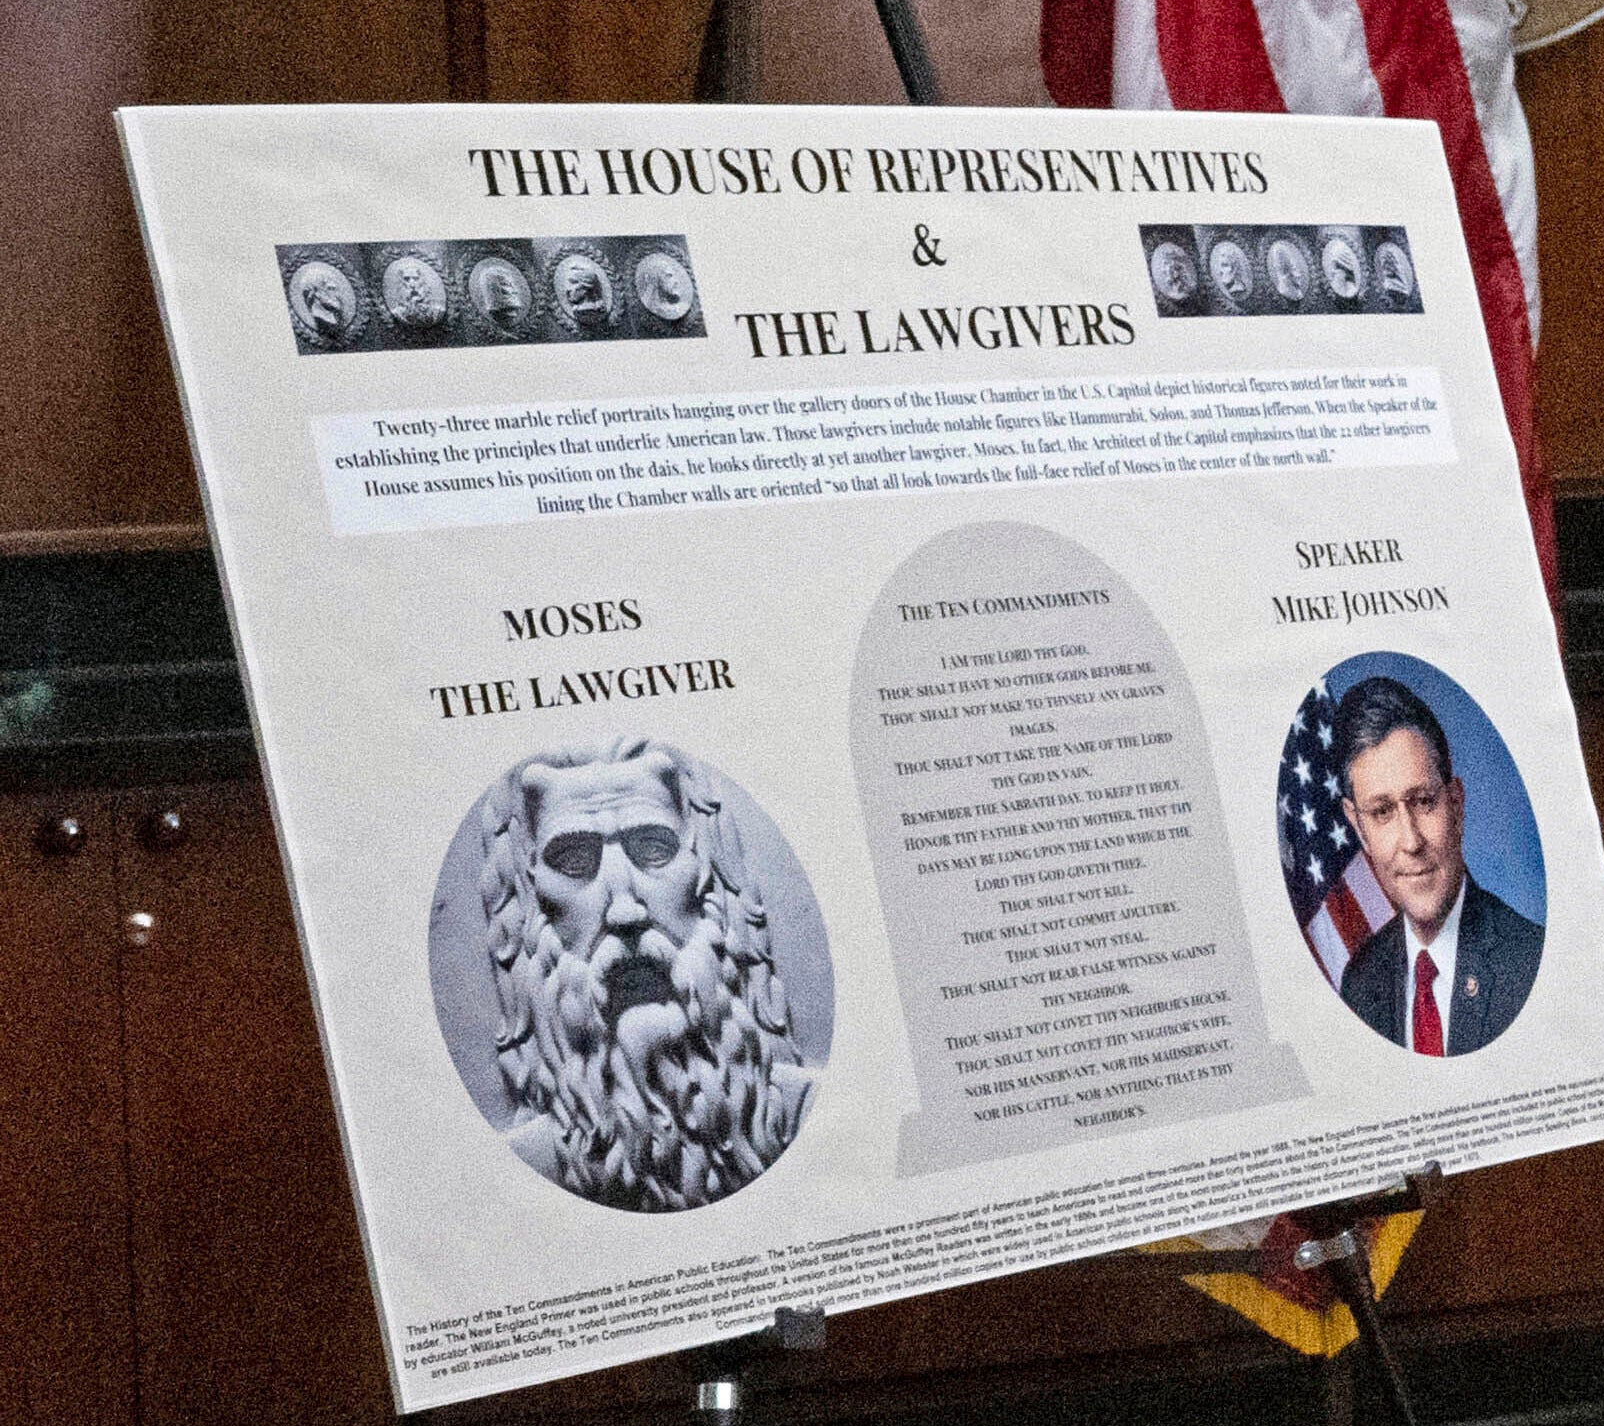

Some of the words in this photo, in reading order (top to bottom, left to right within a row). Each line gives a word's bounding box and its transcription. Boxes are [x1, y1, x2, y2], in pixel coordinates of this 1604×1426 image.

[467, 148, 589, 197] THE
[596, 147, 781, 195] HOUSE
[790, 148, 852, 192] OF
[866, 148, 1268, 193] REPRESENTATIVES
[911, 223, 946, 266] &
[733, 310, 846, 358] THE
[855, 304, 1135, 353] LAWGIVERS
[373, 416, 490, 439] Twenty-three
[493, 409, 552, 431] marble
[555, 406, 598, 426] relief
[600, 404, 670, 427] portraits
[671, 400, 735, 421] hanging
[736, 402, 770, 416] over
[771, 397, 795, 414] the
[798, 395, 846, 416] gallery
[850, 394, 891, 411] doors
[893, 391, 907, 407] of
[909, 390, 932, 407] the
[934, 390, 976, 406] House
[979, 386, 1039, 403] Chamber
[1041, 385, 1055, 401] in
[1056, 384, 1077, 400] the
[1079, 384, 1104, 399] U.S.
[1106, 381, 1152, 400] Capitol
[1153, 381, 1190, 398] depict
[1191, 378, 1247, 394] historical
[1248, 377, 1289, 393] figures
[1290, 376, 1321, 390] noted
[1322, 375, 1339, 389] for
[1340, 374, 1365, 388] their
[1368, 374, 1395, 387] work
[1396, 377, 1407, 387] in
[1294, 538, 1403, 568] SPEAKER
[502, 600, 642, 640] MOSES
[1271, 594, 1333, 623] MIKE
[1341, 586, 1449, 623] JOHNSON
[429, 679, 520, 719] THE
[529, 659, 734, 709] LAWGIVER
